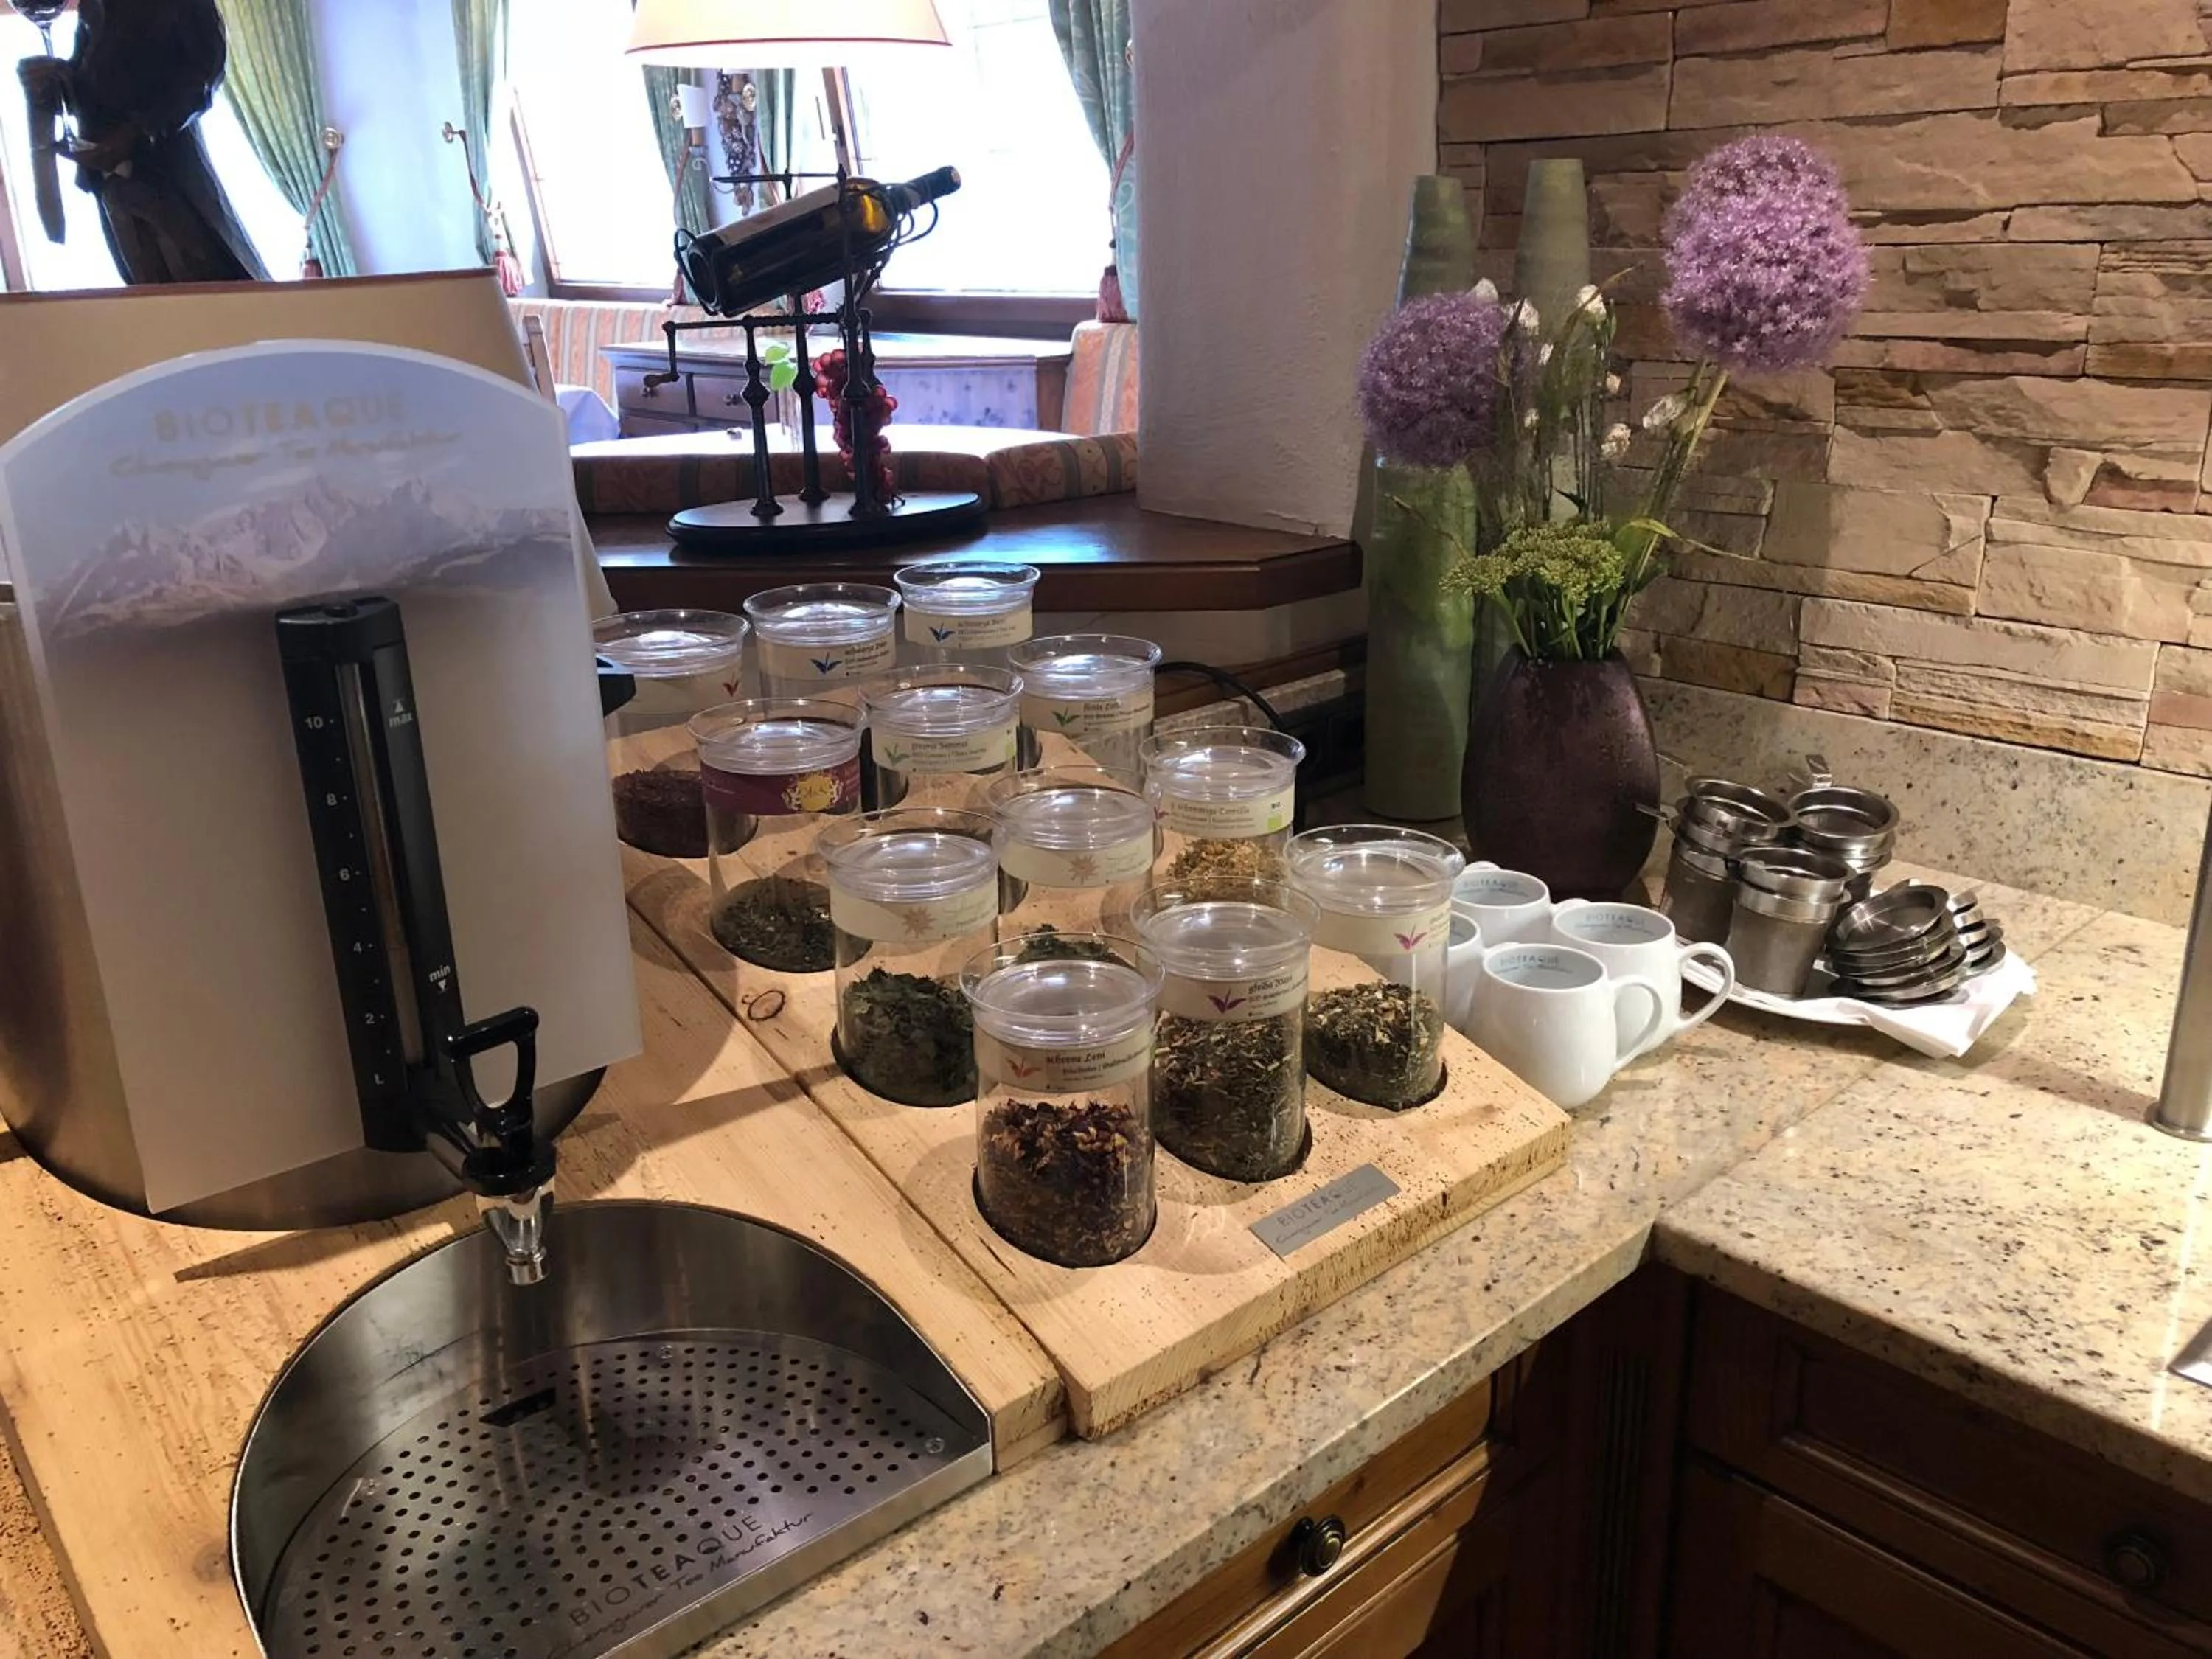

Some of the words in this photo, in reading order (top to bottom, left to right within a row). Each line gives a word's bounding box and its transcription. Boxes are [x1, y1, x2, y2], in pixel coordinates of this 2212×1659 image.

[154, 391, 405, 441] BIOTEAQUE
[305, 717, 324, 729] 10
[389, 712, 413, 728] max
[326, 793, 337, 806] 8
[338, 869, 349, 881] 6
[353, 942, 363, 953] 4
[429, 964, 451, 983] min
[366, 1013, 375, 1025] 2
[709, 1512, 813, 1573] Manufaktur
[568, 1515, 762, 1626] BIOTEAQUE
